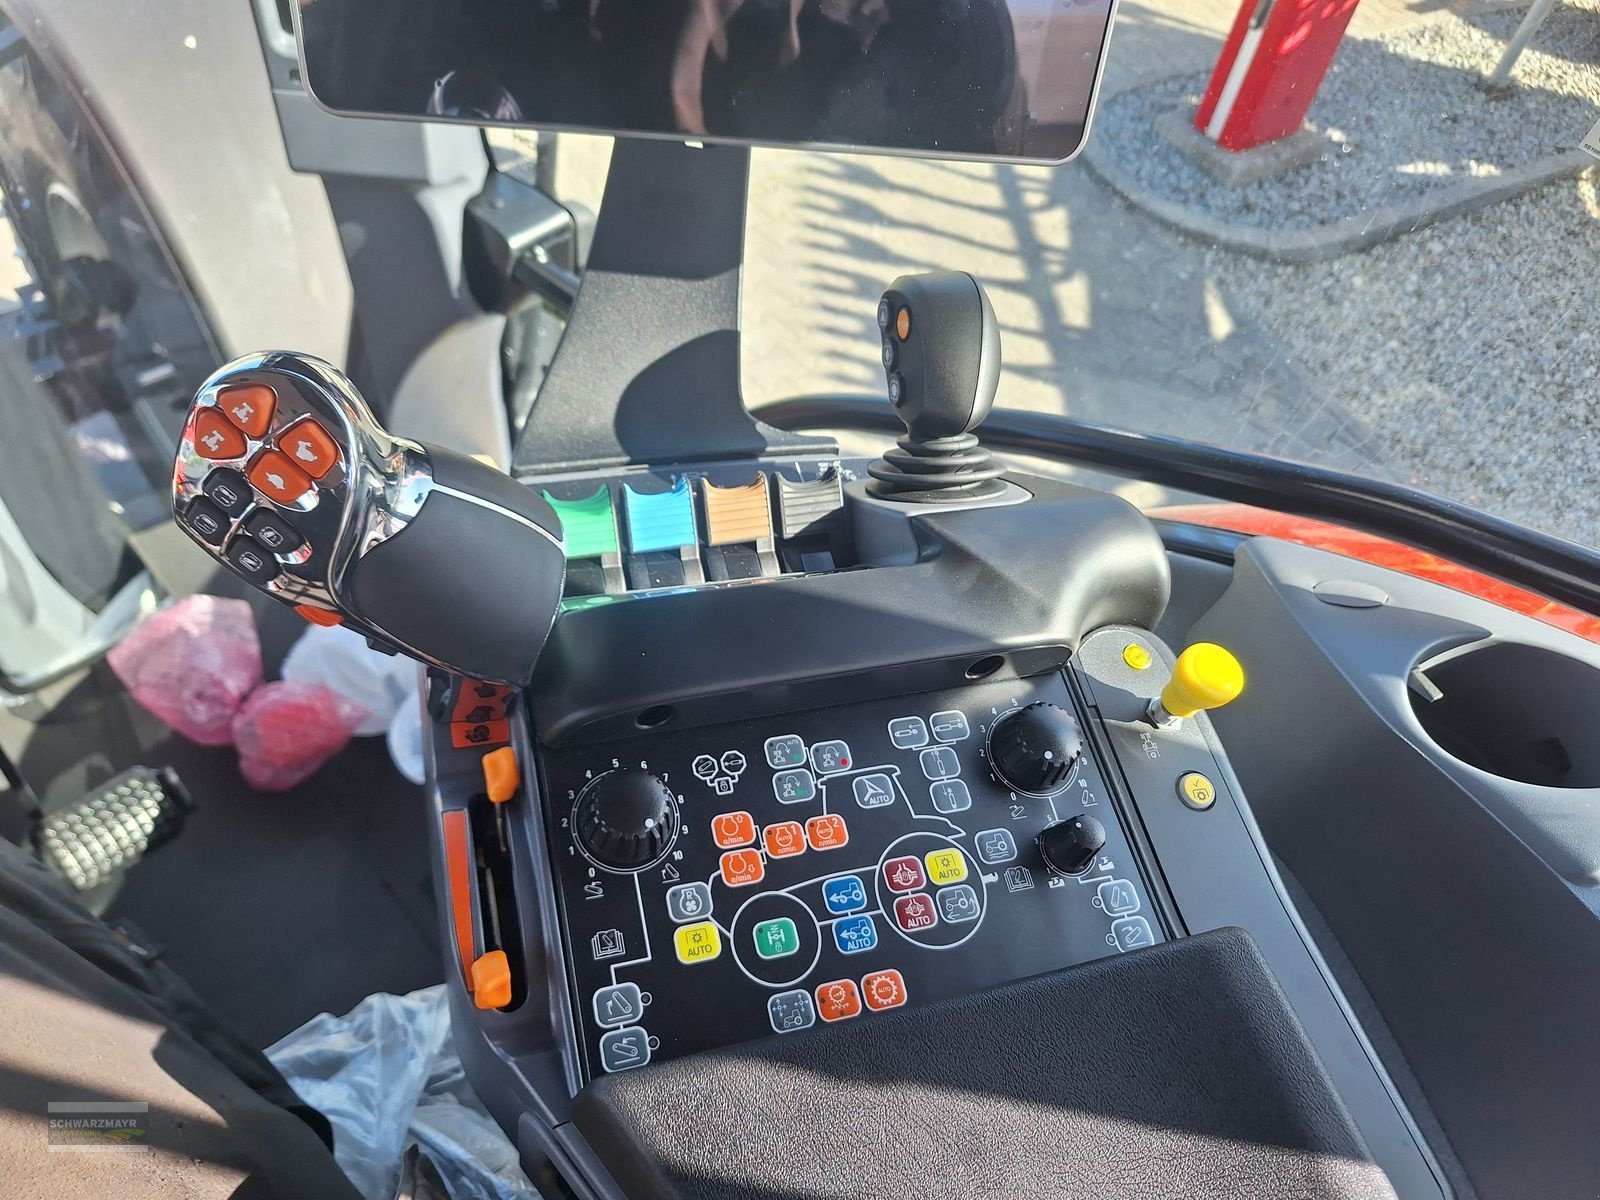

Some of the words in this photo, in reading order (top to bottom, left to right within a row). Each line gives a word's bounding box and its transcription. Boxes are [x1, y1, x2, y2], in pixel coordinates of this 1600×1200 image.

[1011, 698, 1018, 706] 5
[991, 707, 997, 715] 4
[979, 725, 986, 733] 3
[786, 738, 799, 746] AUTO
[979, 749, 986, 757] 2
[612, 758, 619, 768] 5
[640, 761, 647, 770] 6
[1081, 757, 1088, 766] 9
[585, 770, 592, 779] 4
[662, 773, 669, 782] 7
[1079, 778, 1088, 788] 10
[567, 790, 575, 799] 3
[1010, 792, 1017, 801] 0
[677, 795, 685, 804] 8
[869, 794, 890, 806] AUTO
[561, 818, 568, 827] 2
[831, 818, 840, 828] 2
[681, 825, 689, 834] 9
[791, 824, 797, 835] 1
[722, 836, 744, 845] n/min
[818, 838, 838, 847] n/min
[569, 846, 575, 855] 1
[672, 850, 684, 860] 10
[777, 846, 797, 855] n/min
[588, 868, 596, 877] 0
[938, 868, 961, 880] AUTO
[730, 874, 752, 884] n/min
[907, 915, 930, 928] AUTO
[847, 937, 871, 951] AUTO
[687, 943, 713, 958] AUTO
[877, 986, 891, 994] AUTO
